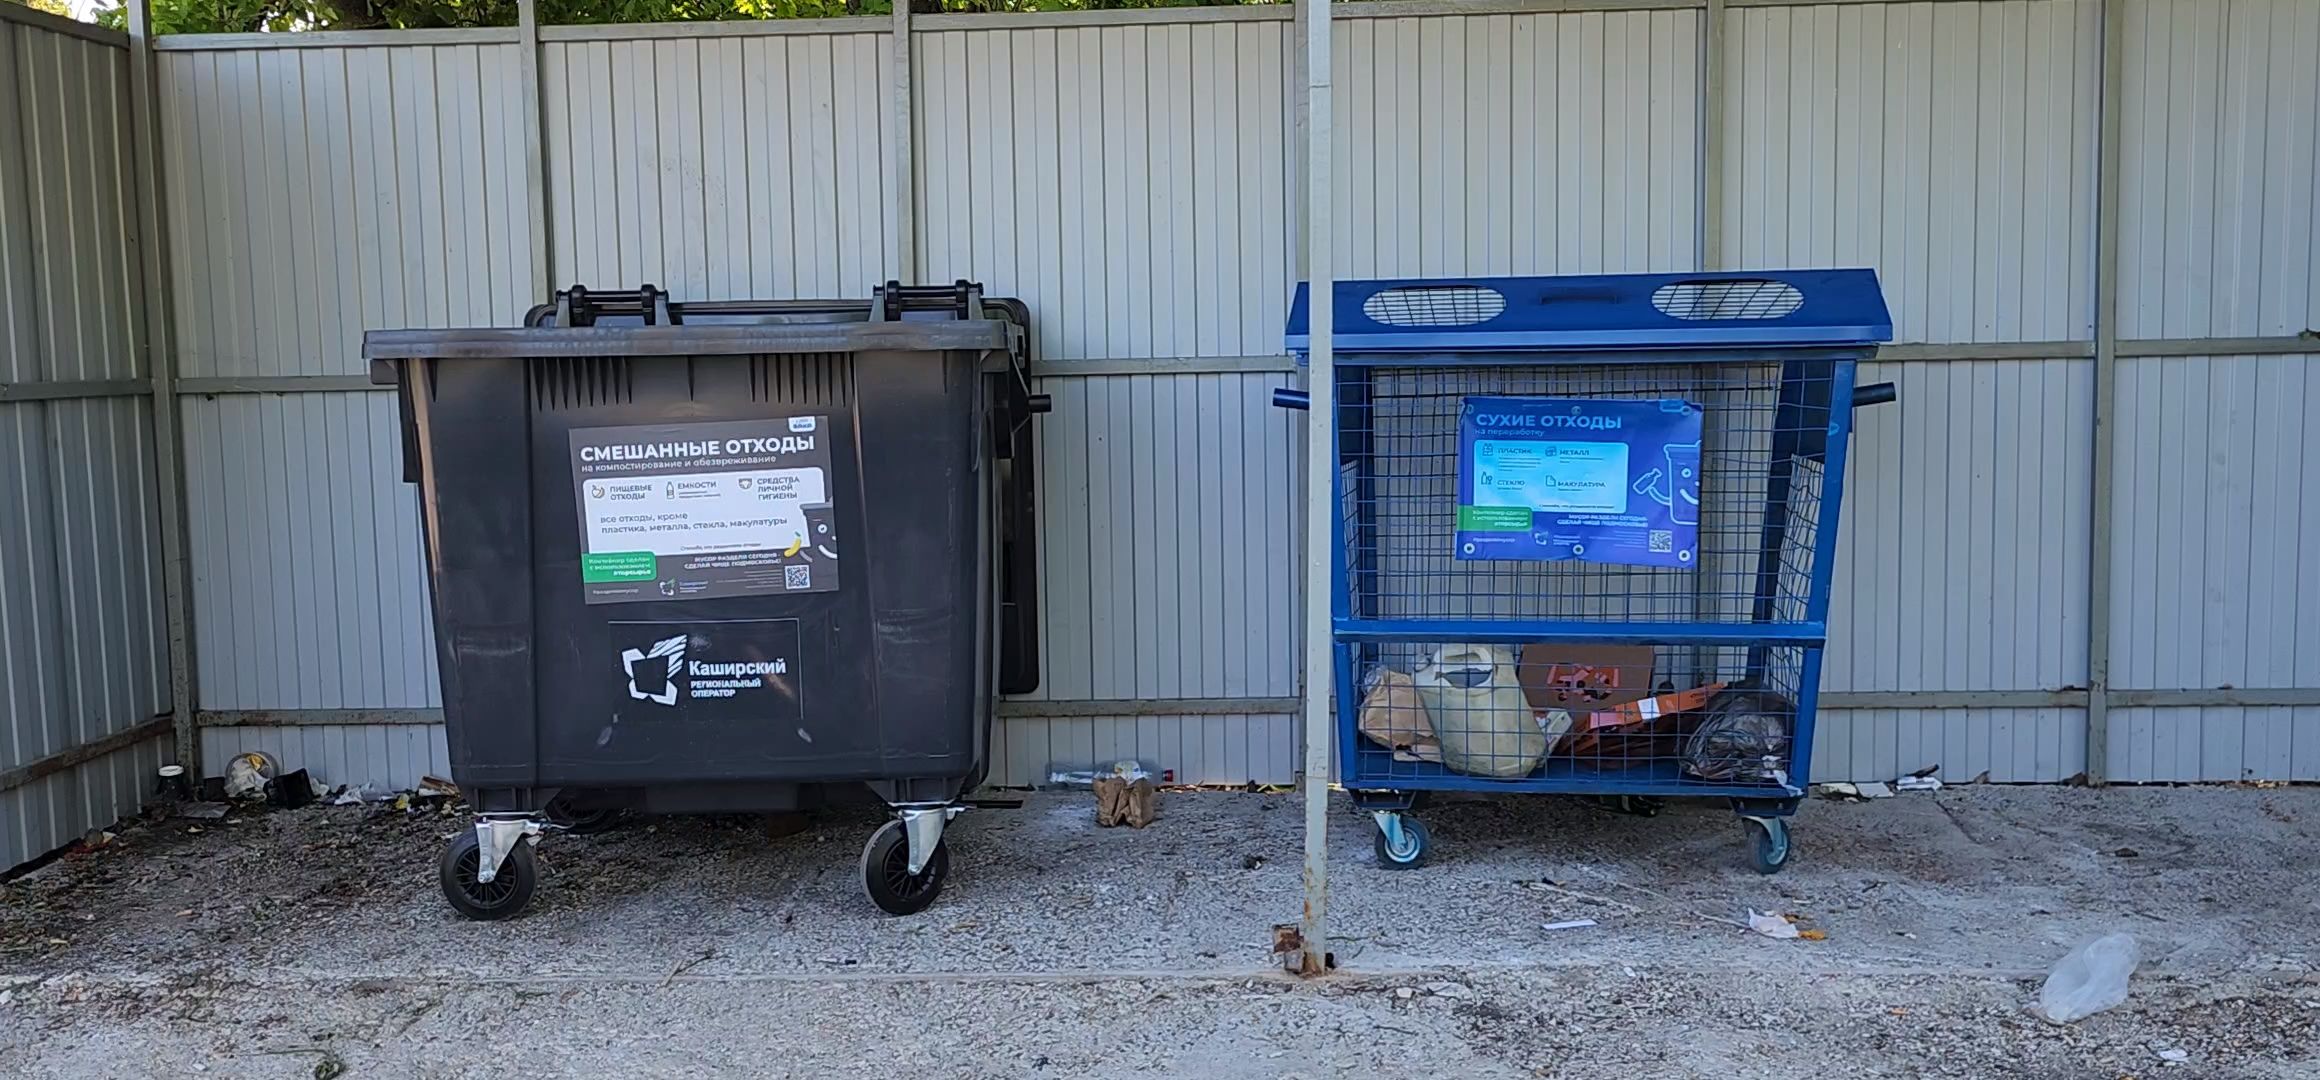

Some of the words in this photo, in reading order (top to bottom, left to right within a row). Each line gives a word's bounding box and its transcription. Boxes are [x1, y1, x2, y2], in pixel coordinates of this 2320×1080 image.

[1476, 414, 1536, 426] СУХИЕ
[1540, 416, 1622, 430] ОТХОДЫ
[1487, 429, 1545, 437] переработку
[581, 441, 720, 461] СМЕШАННЫЕ
[725, 436, 815, 454] ОТХОДЫ
[582, 464, 593, 472] на
[596, 460, 682, 471] компостирование
[684, 459, 691, 467] и
[693, 456, 776, 467] обезвреживание
[757, 476, 800, 485] СРЕДСТВА
[610, 484, 652, 493] ПИЩЕВЫЕ
[758, 484, 793, 493] ЛИЧНОЙ
[610, 493, 646, 501] ОТХОДЫ
[758, 492, 797, 501] ГИГИЕНЫ
[658, 513, 688, 522] кроме
[650, 523, 691, 532] металла,
[730, 518, 788, 528] макулатуры
[689, 658, 786, 678] Каширский
[690, 678, 761, 688] РЕГИОНАЛЬНЫЙ
[691, 689, 736, 697] ОПЕРАТОР
